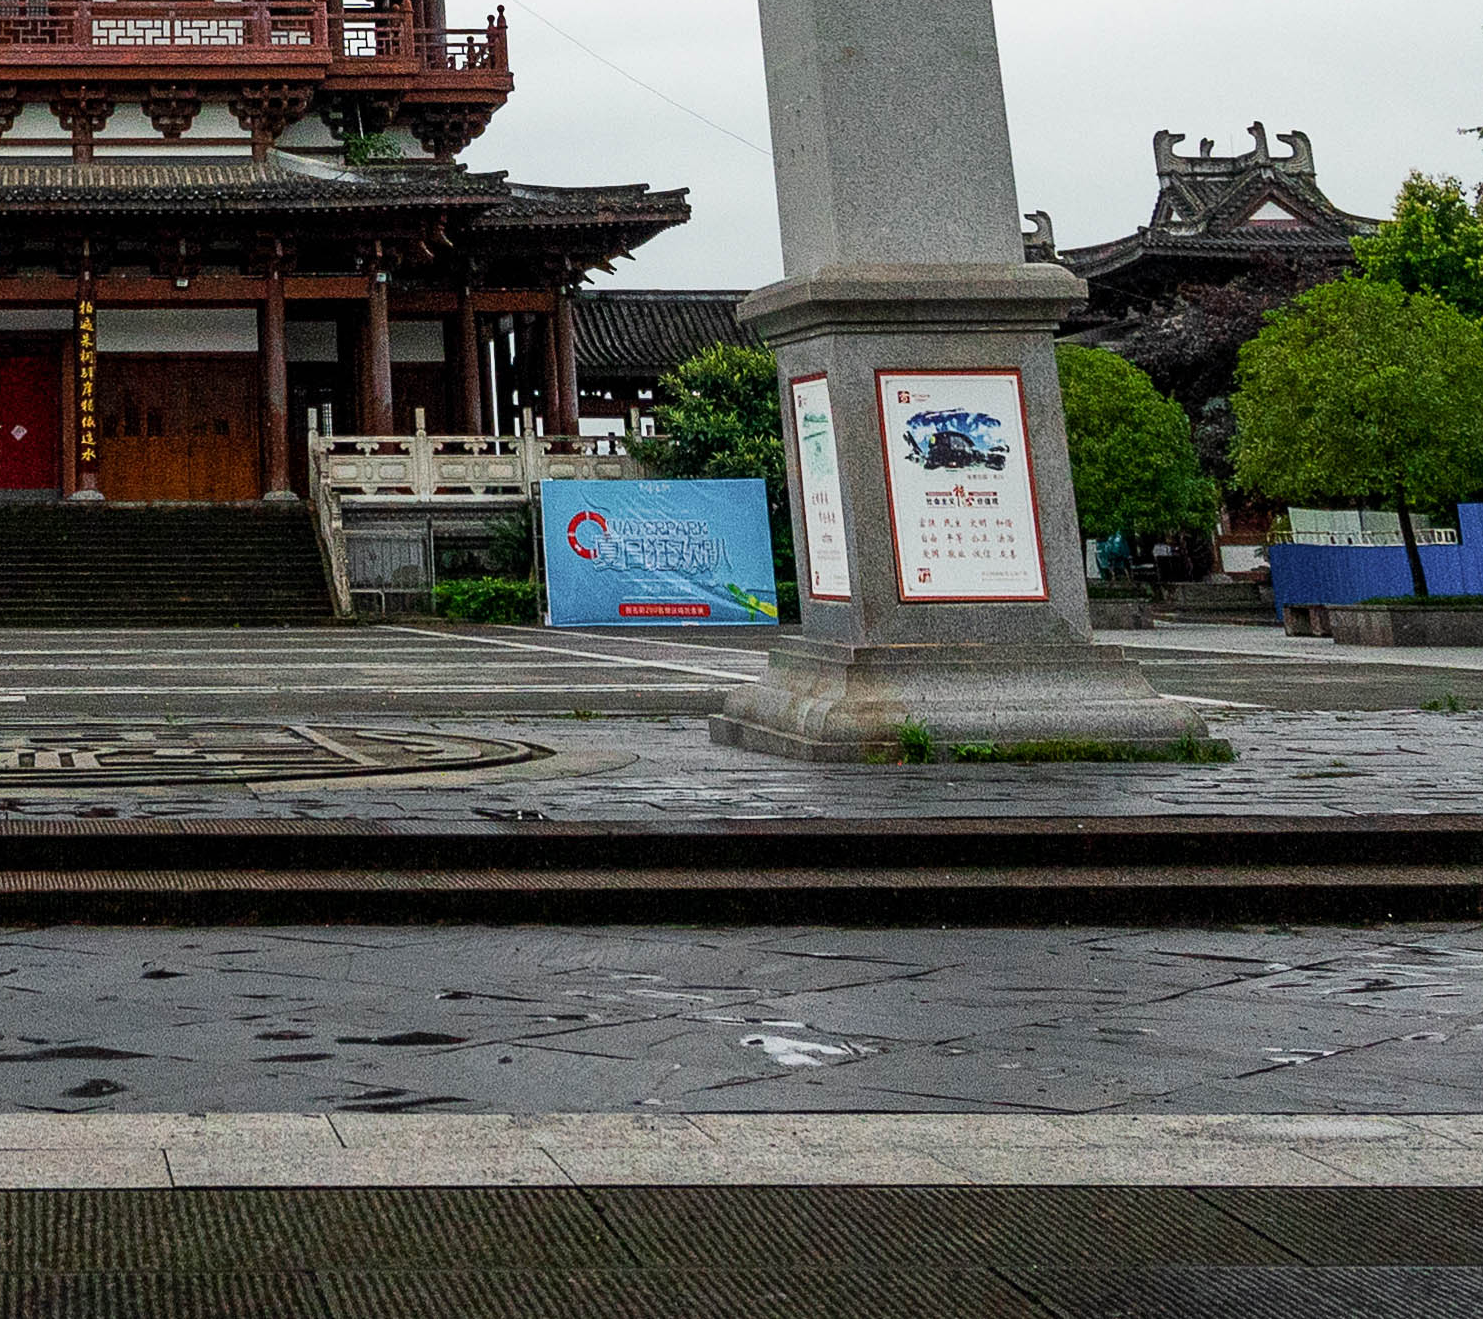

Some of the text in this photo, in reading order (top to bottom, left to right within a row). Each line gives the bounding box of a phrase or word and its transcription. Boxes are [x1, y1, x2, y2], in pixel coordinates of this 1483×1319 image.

[594, 536, 733, 573] 夏日狂欢趴
